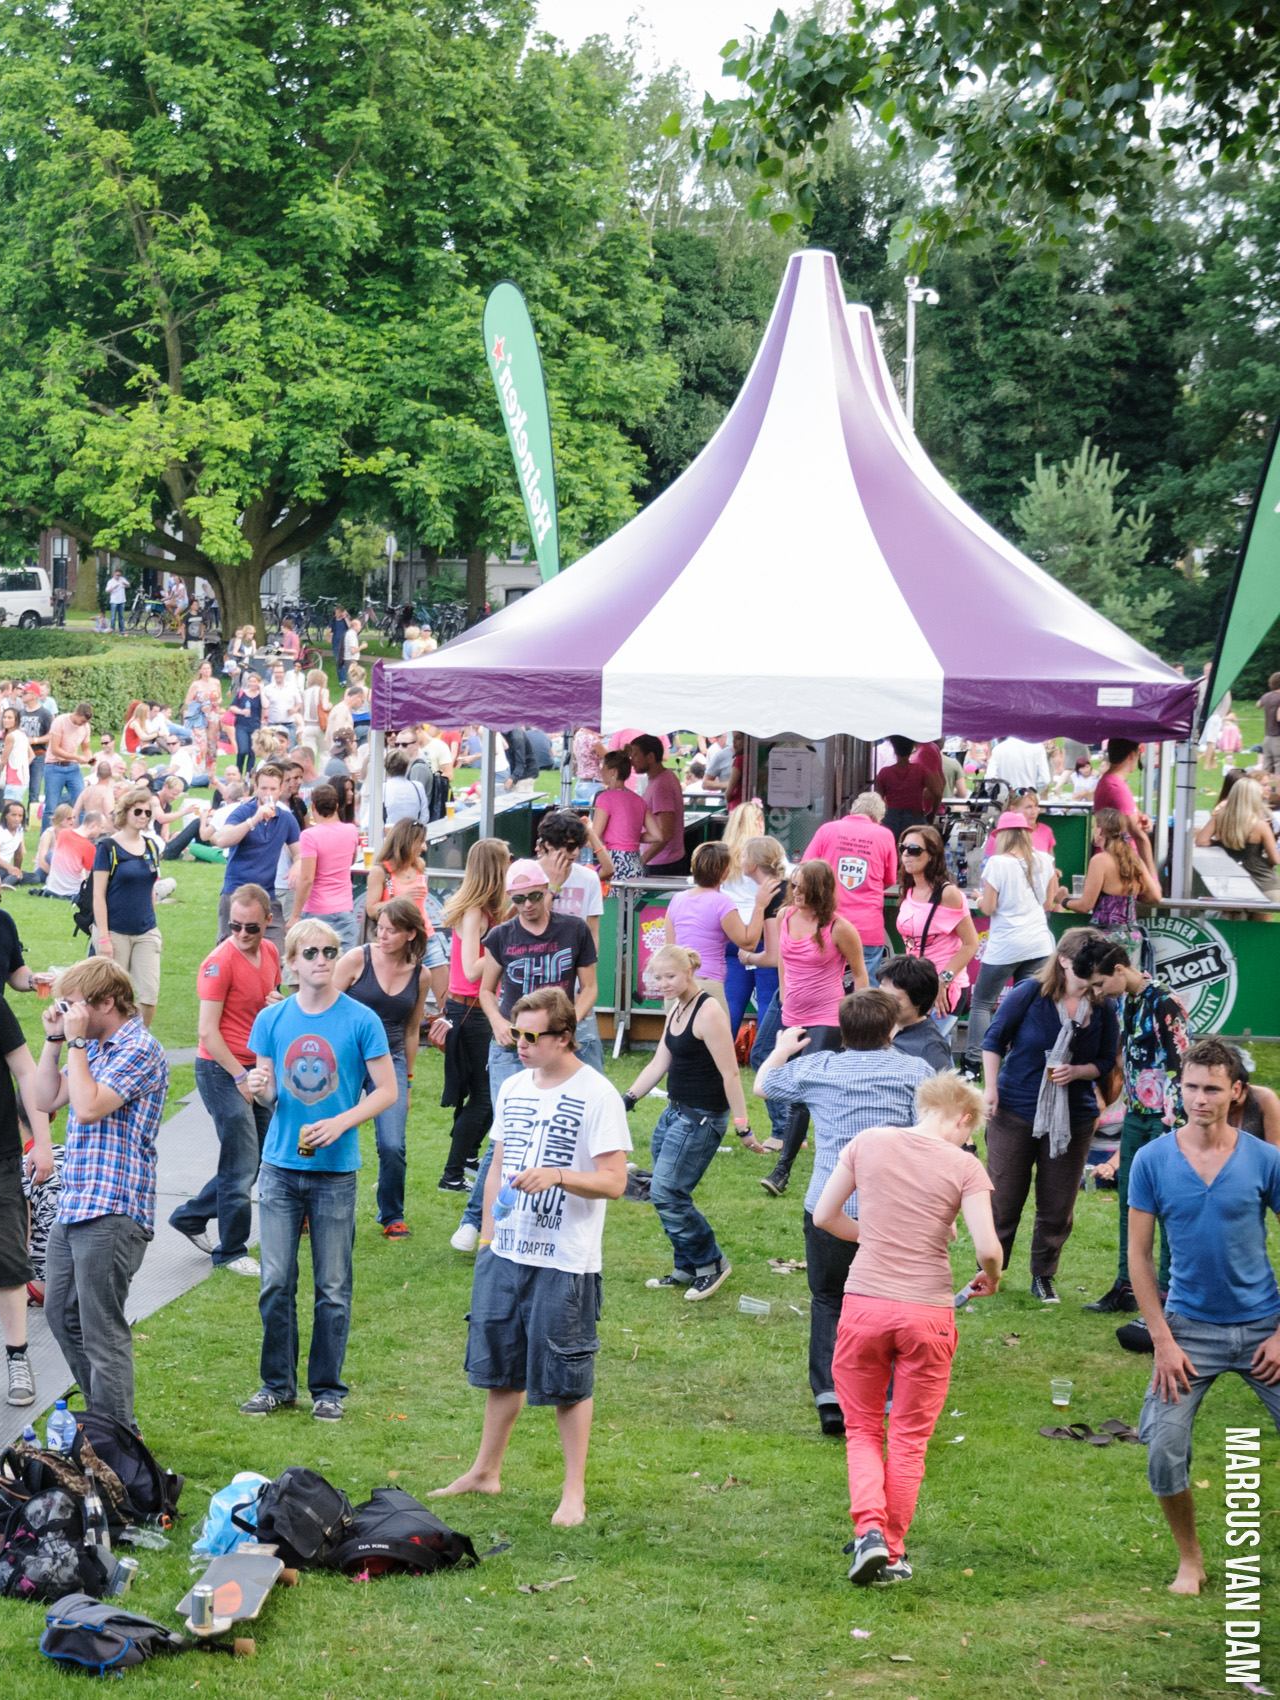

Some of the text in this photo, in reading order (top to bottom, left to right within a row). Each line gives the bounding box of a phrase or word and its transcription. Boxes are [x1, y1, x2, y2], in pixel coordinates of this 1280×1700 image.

[841, 864, 863, 874] DPK
[528, 942, 559, 953] PROFILE
[1156, 949, 1220, 986] eken
[1190, 993, 1220, 1033] UALITY
[304, 1042, 317, 1051] M
[541, 1094, 586, 1168] JUGEMEN
[535, 1213, 563, 1231] POUR
[516, 1239, 556, 1257] ADAPTER
